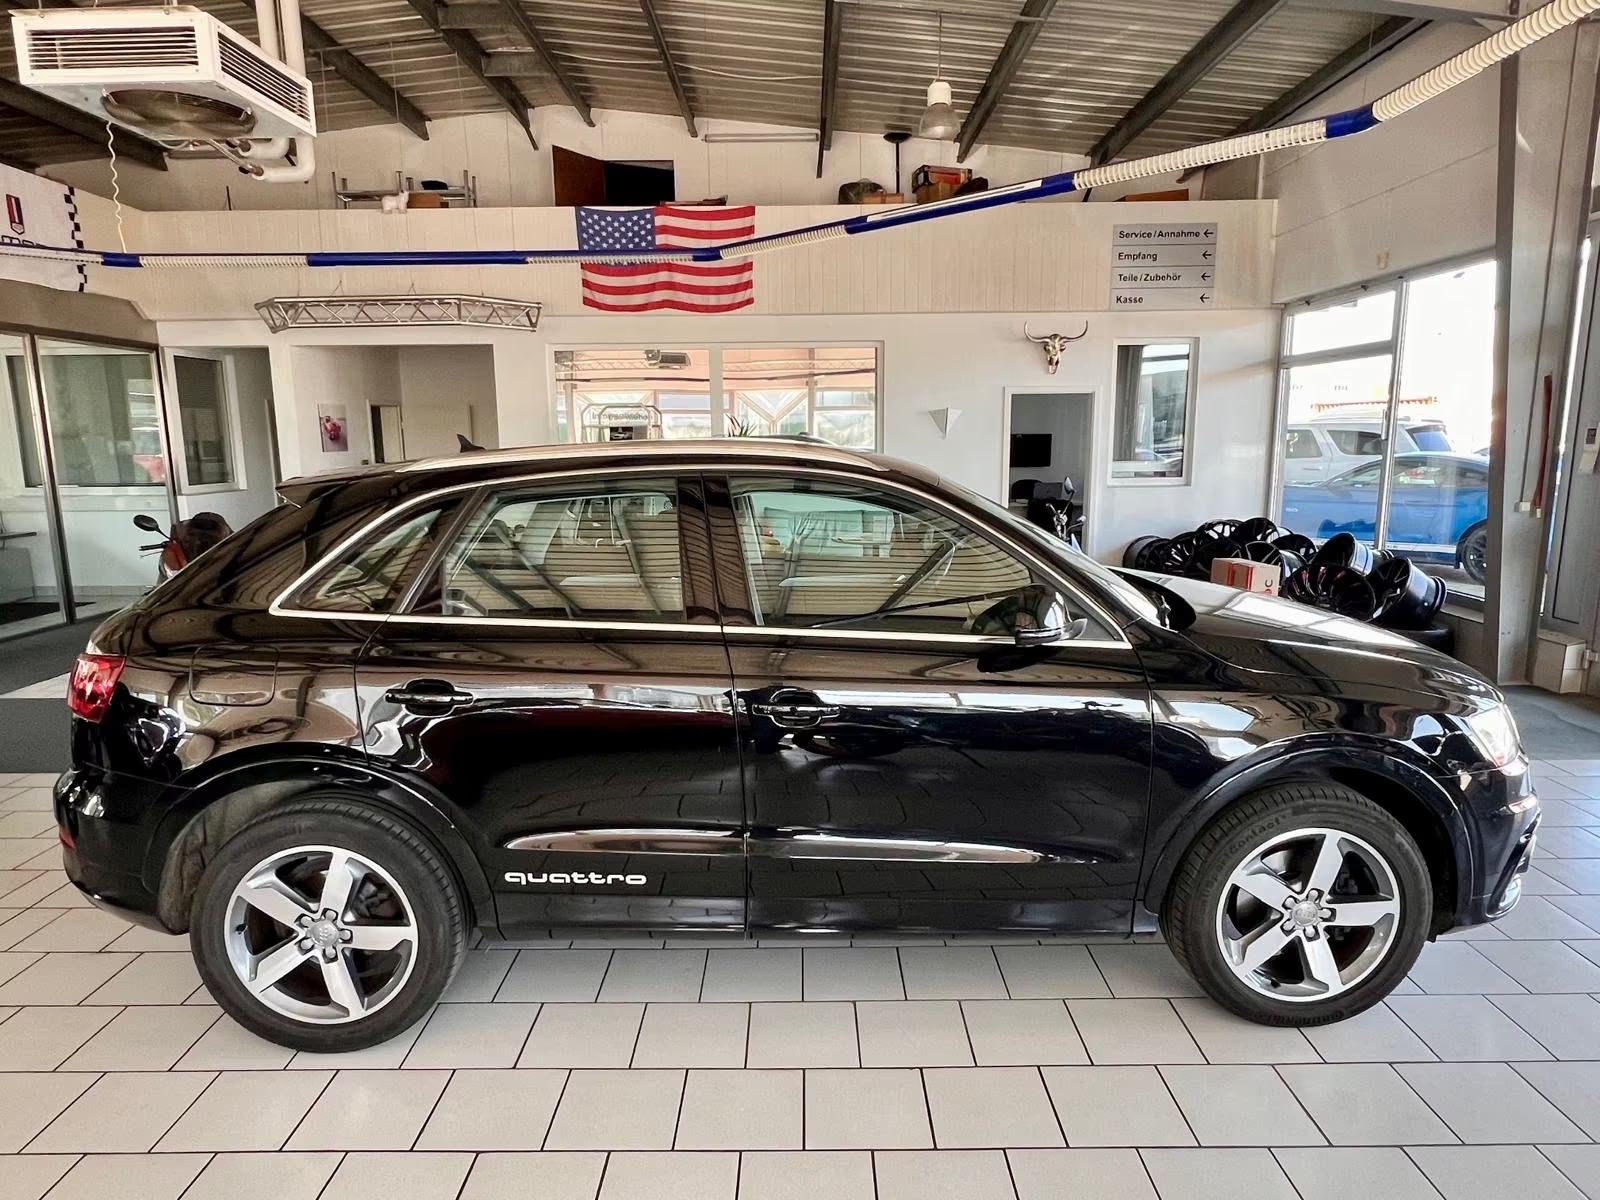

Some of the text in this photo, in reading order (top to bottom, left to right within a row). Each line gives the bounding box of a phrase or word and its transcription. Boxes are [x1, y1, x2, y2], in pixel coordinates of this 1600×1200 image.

[1118, 229, 1201, 239] Service/Annahme
[1117, 251, 1158, 262] Empfang
[1117, 273, 1182, 282] Teile/Zubehör
[1115, 295, 1144, 304] Kasse
[504, 871, 647, 886] quattro
